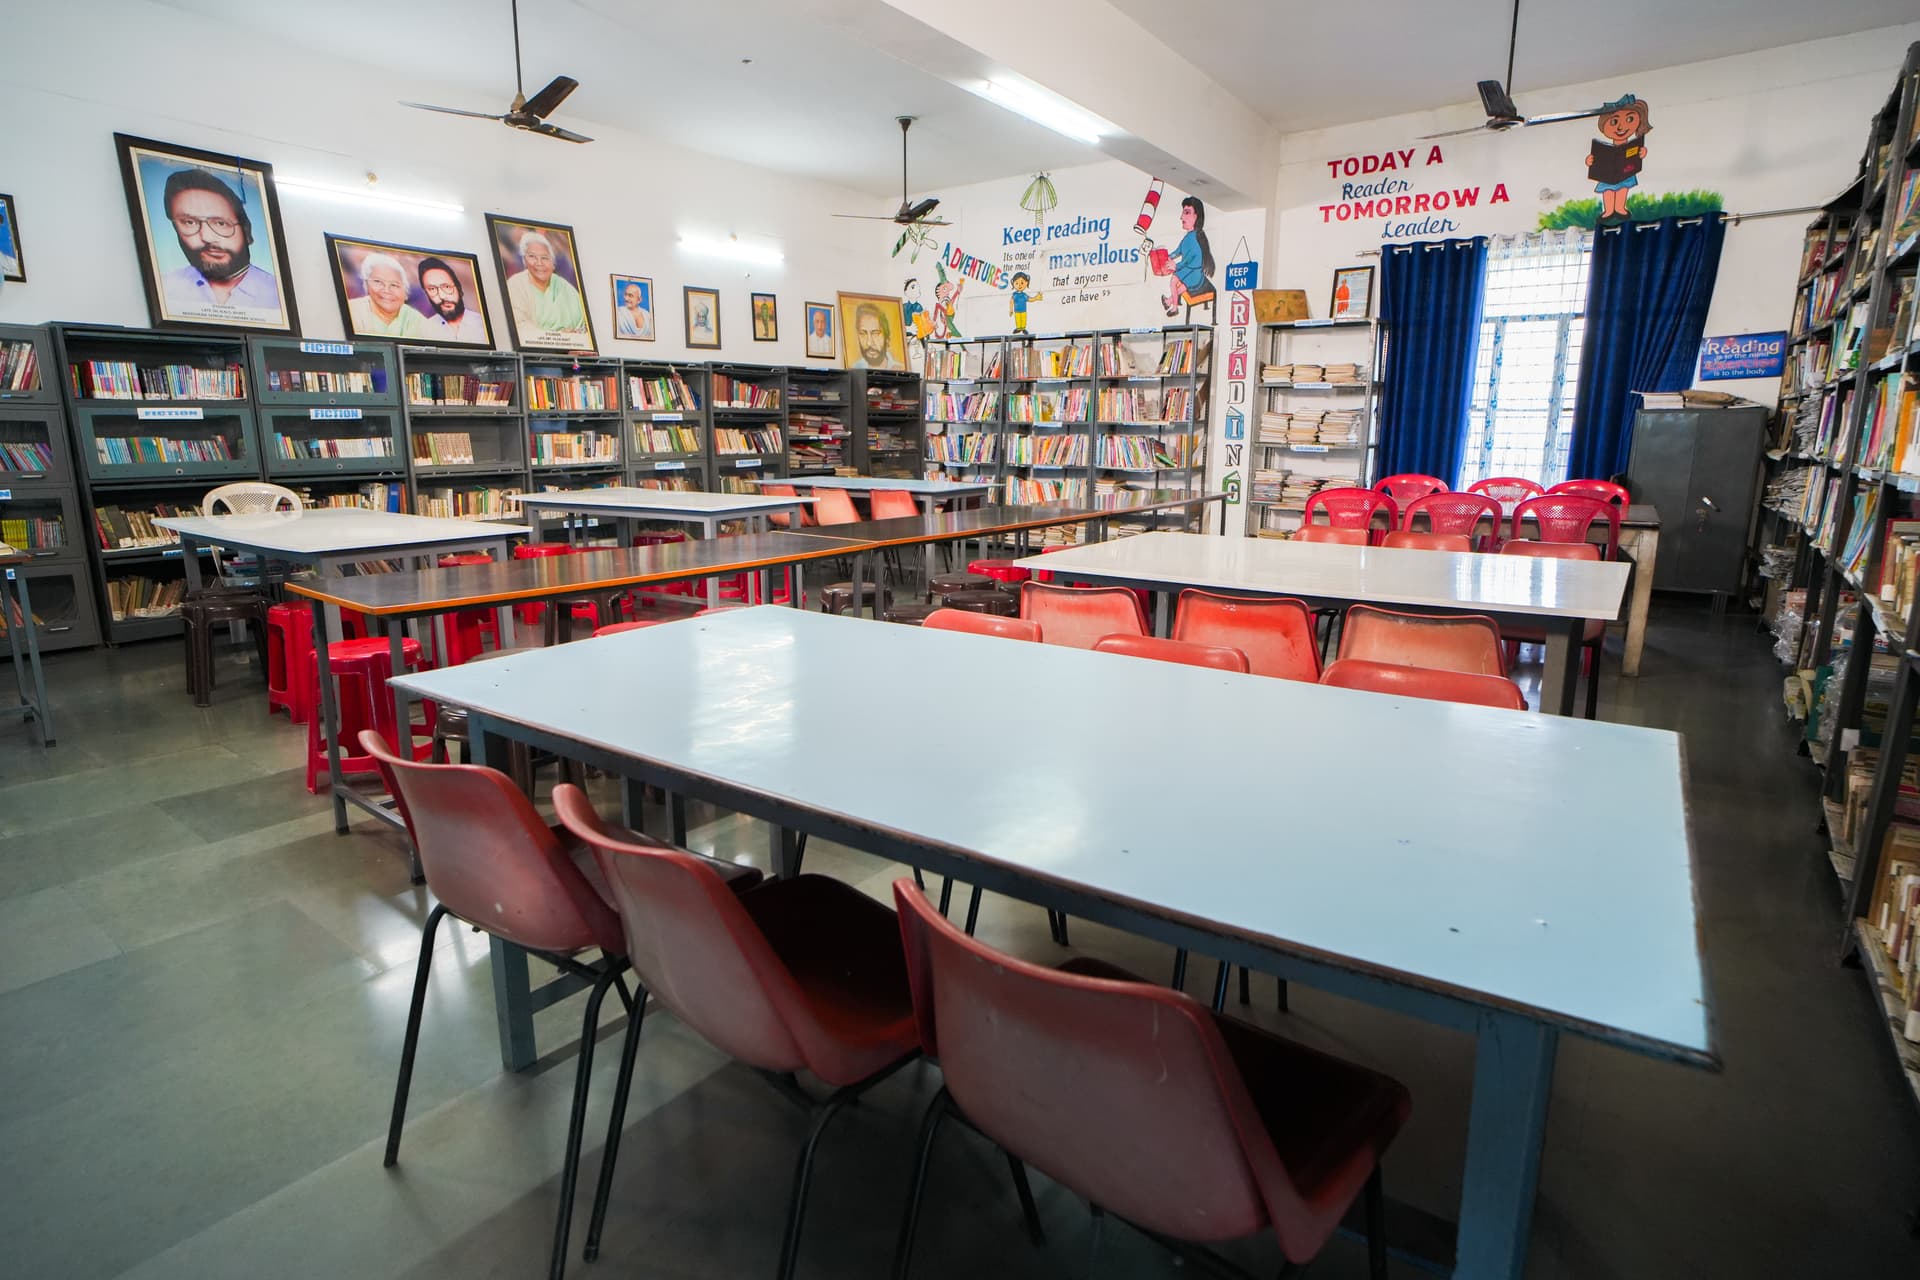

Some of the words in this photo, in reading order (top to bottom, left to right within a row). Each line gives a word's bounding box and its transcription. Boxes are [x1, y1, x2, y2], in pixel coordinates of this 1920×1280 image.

[1327, 149, 1415, 178] TODAY
[1426, 145, 1443, 166] A
[1342, 177, 1415, 200] Reader
[1319, 187, 1480, 223] TOMORROW
[1489, 183, 1510, 204] A
[1003, 226, 1041, 246] Keep
[1047, 215, 1111, 240] reading
[1381, 216, 1460, 238] Leader
[1015, 252, 1028, 261] one
[1028, 249, 1036, 260] of
[1049, 243, 1139, 270] marvellous
[942, 242, 1009, 289] ADVENTURES
[1003, 263, 1013, 272] the
[1015, 261, 1031, 271] most
[1229, 267, 1249, 278] KEEP
[1074, 273, 1109, 289] anyone
[1233, 278, 1247, 288] ON
[1061, 294, 1076, 304] can
[304, 343, 350, 354] FICTION
[1707, 340, 1780, 355] Reading
[314, 409, 359, 418] FICTION
